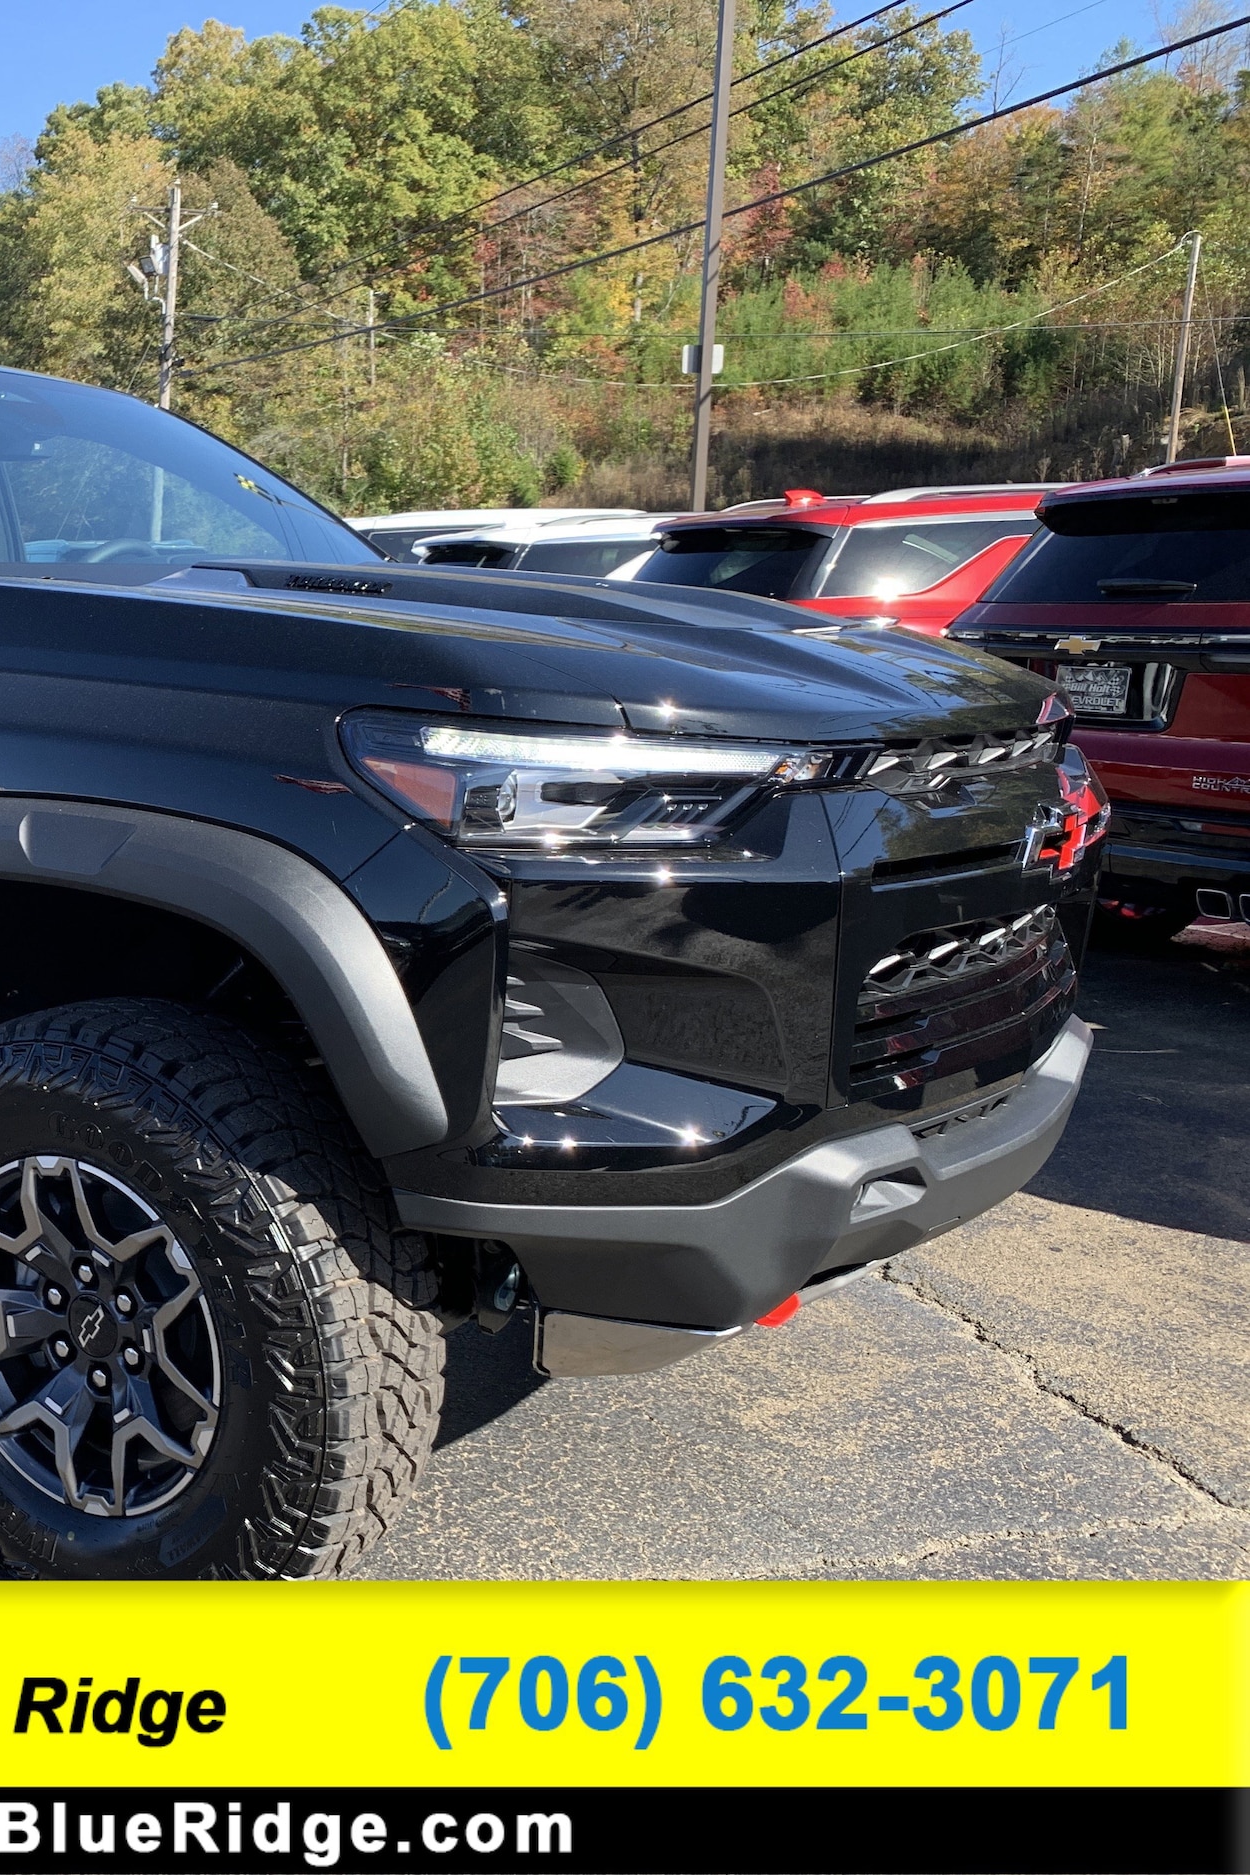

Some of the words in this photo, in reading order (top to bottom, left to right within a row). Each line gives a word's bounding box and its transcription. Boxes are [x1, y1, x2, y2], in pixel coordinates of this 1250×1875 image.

[1070, 683, 1087, 692] Bill
[1090, 683, 1111, 694] Holt
[1072, 695, 1121, 708] EVROLET
[1192, 776, 1227, 785] HIGH
[1192, 782, 1250, 794] COUNTR
